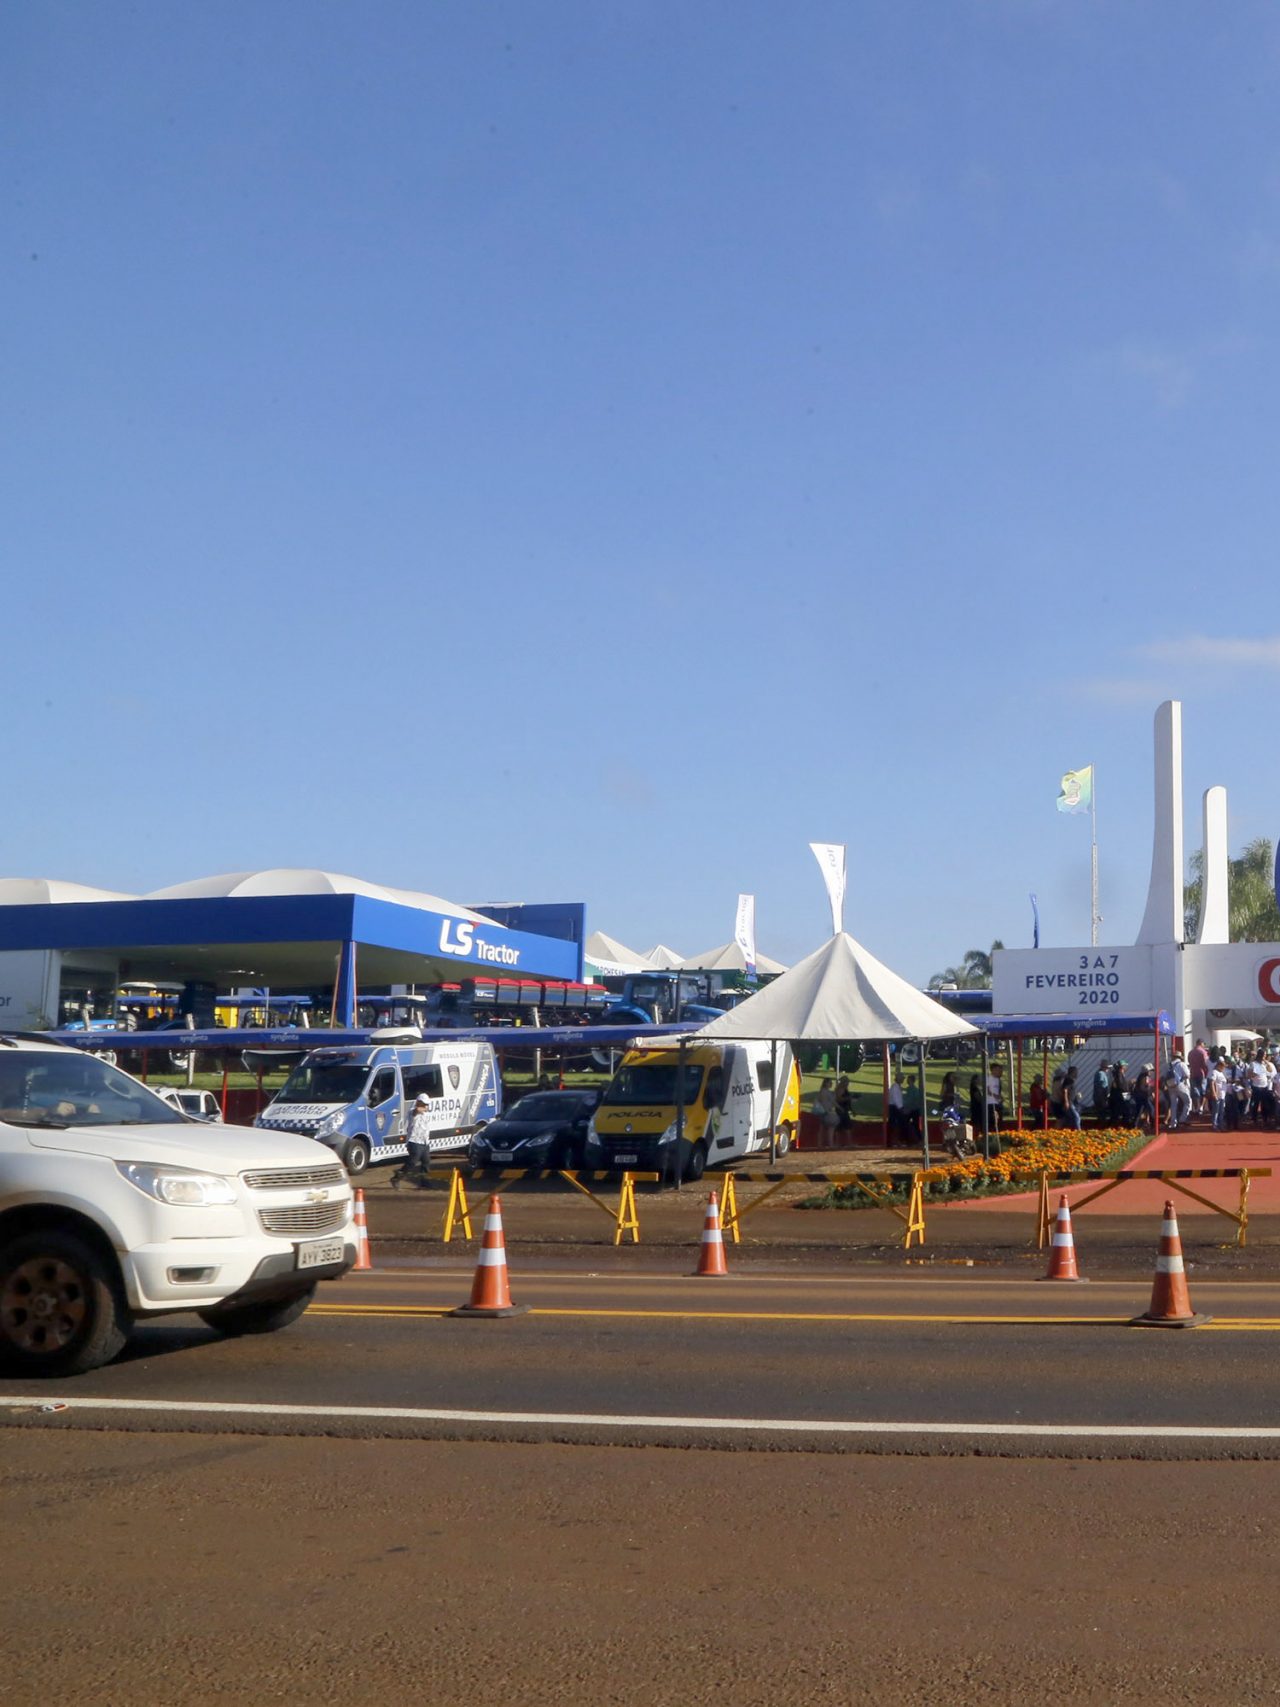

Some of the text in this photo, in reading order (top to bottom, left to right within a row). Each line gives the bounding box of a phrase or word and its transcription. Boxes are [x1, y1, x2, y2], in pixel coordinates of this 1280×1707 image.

[439, 919, 520, 965] LS Tractor
[1079, 955, 1119, 969] 3 A 7
[1026, 973, 1119, 988] FEVEREIRO
[1079, 990, 1119, 1004] 2020
[1073, 1018, 1106, 1029] syngenta
[428, 1099, 461, 1113] UARDA
